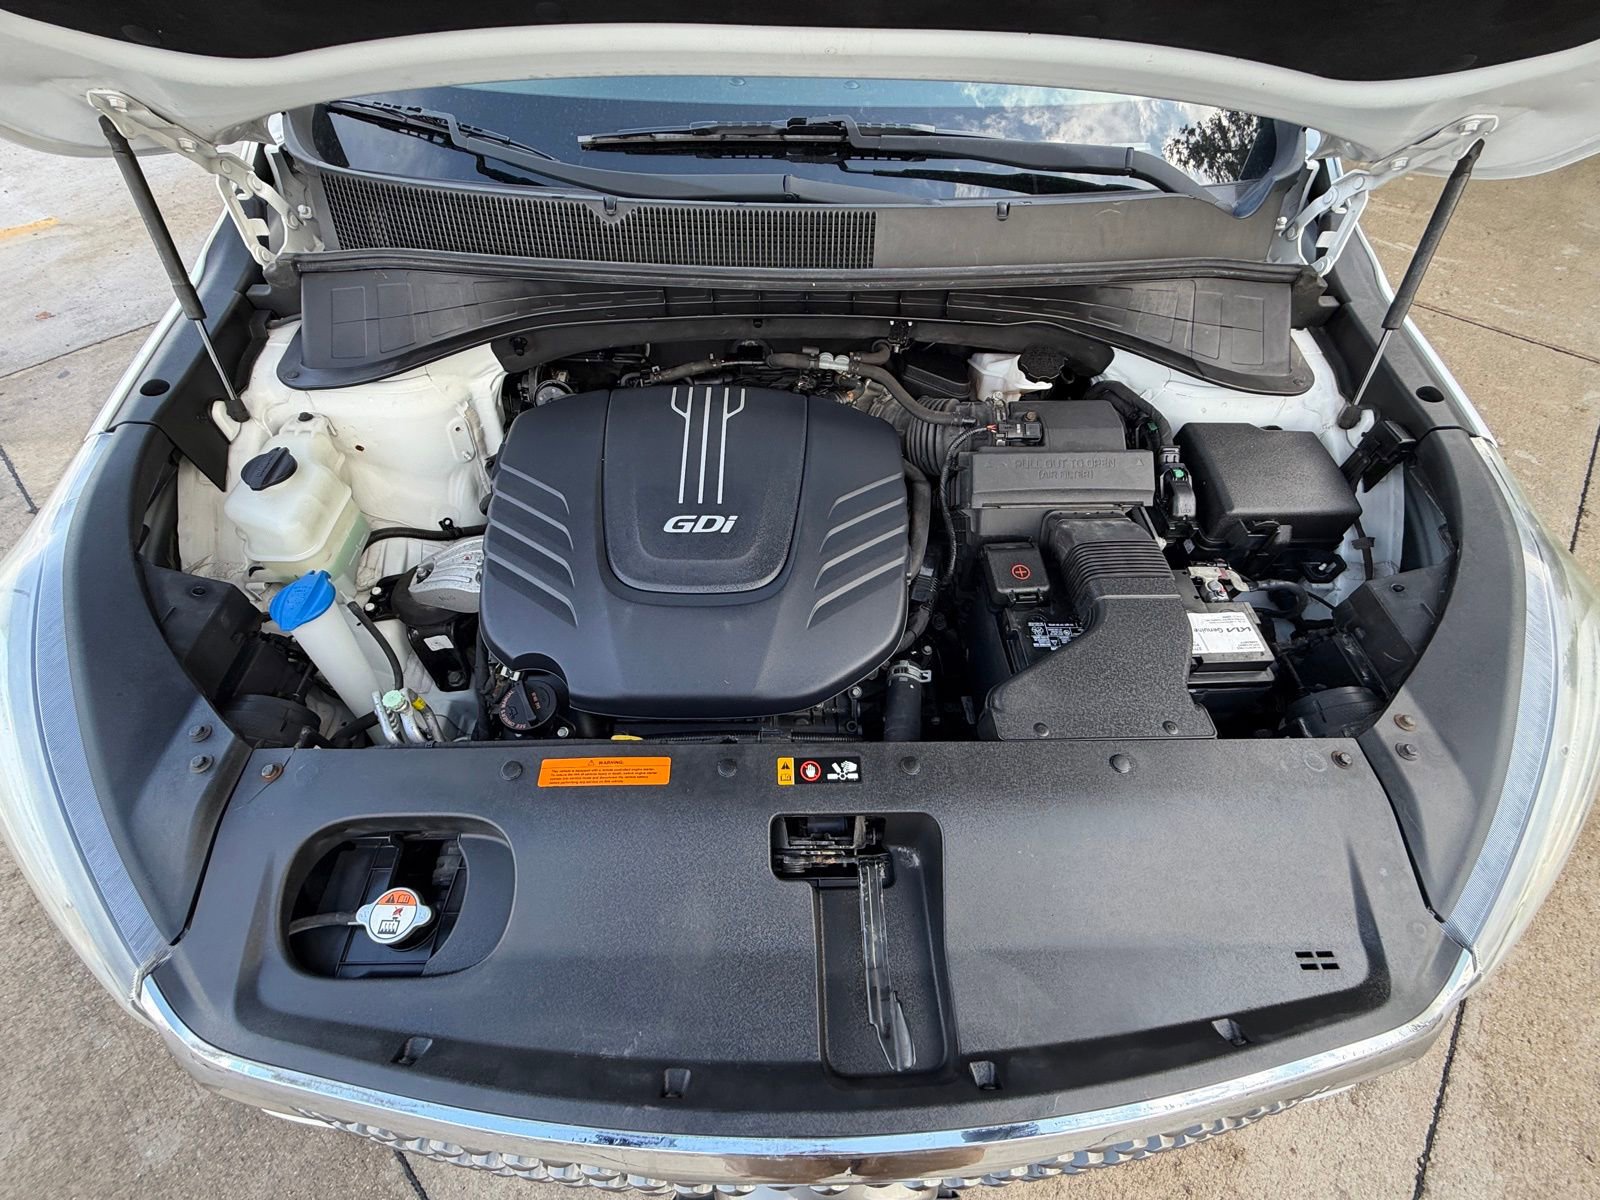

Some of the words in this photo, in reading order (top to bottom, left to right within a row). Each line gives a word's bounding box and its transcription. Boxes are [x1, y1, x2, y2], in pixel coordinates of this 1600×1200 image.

[1015, 458, 1042, 469] PULL
[1044, 458, 1067, 468] OUT
[1071, 457, 1086, 468] TO
[1087, 457, 1117, 468] OPEN
[663, 515, 739, 533] GDi
[1193, 626, 1224, 634] Genuine
